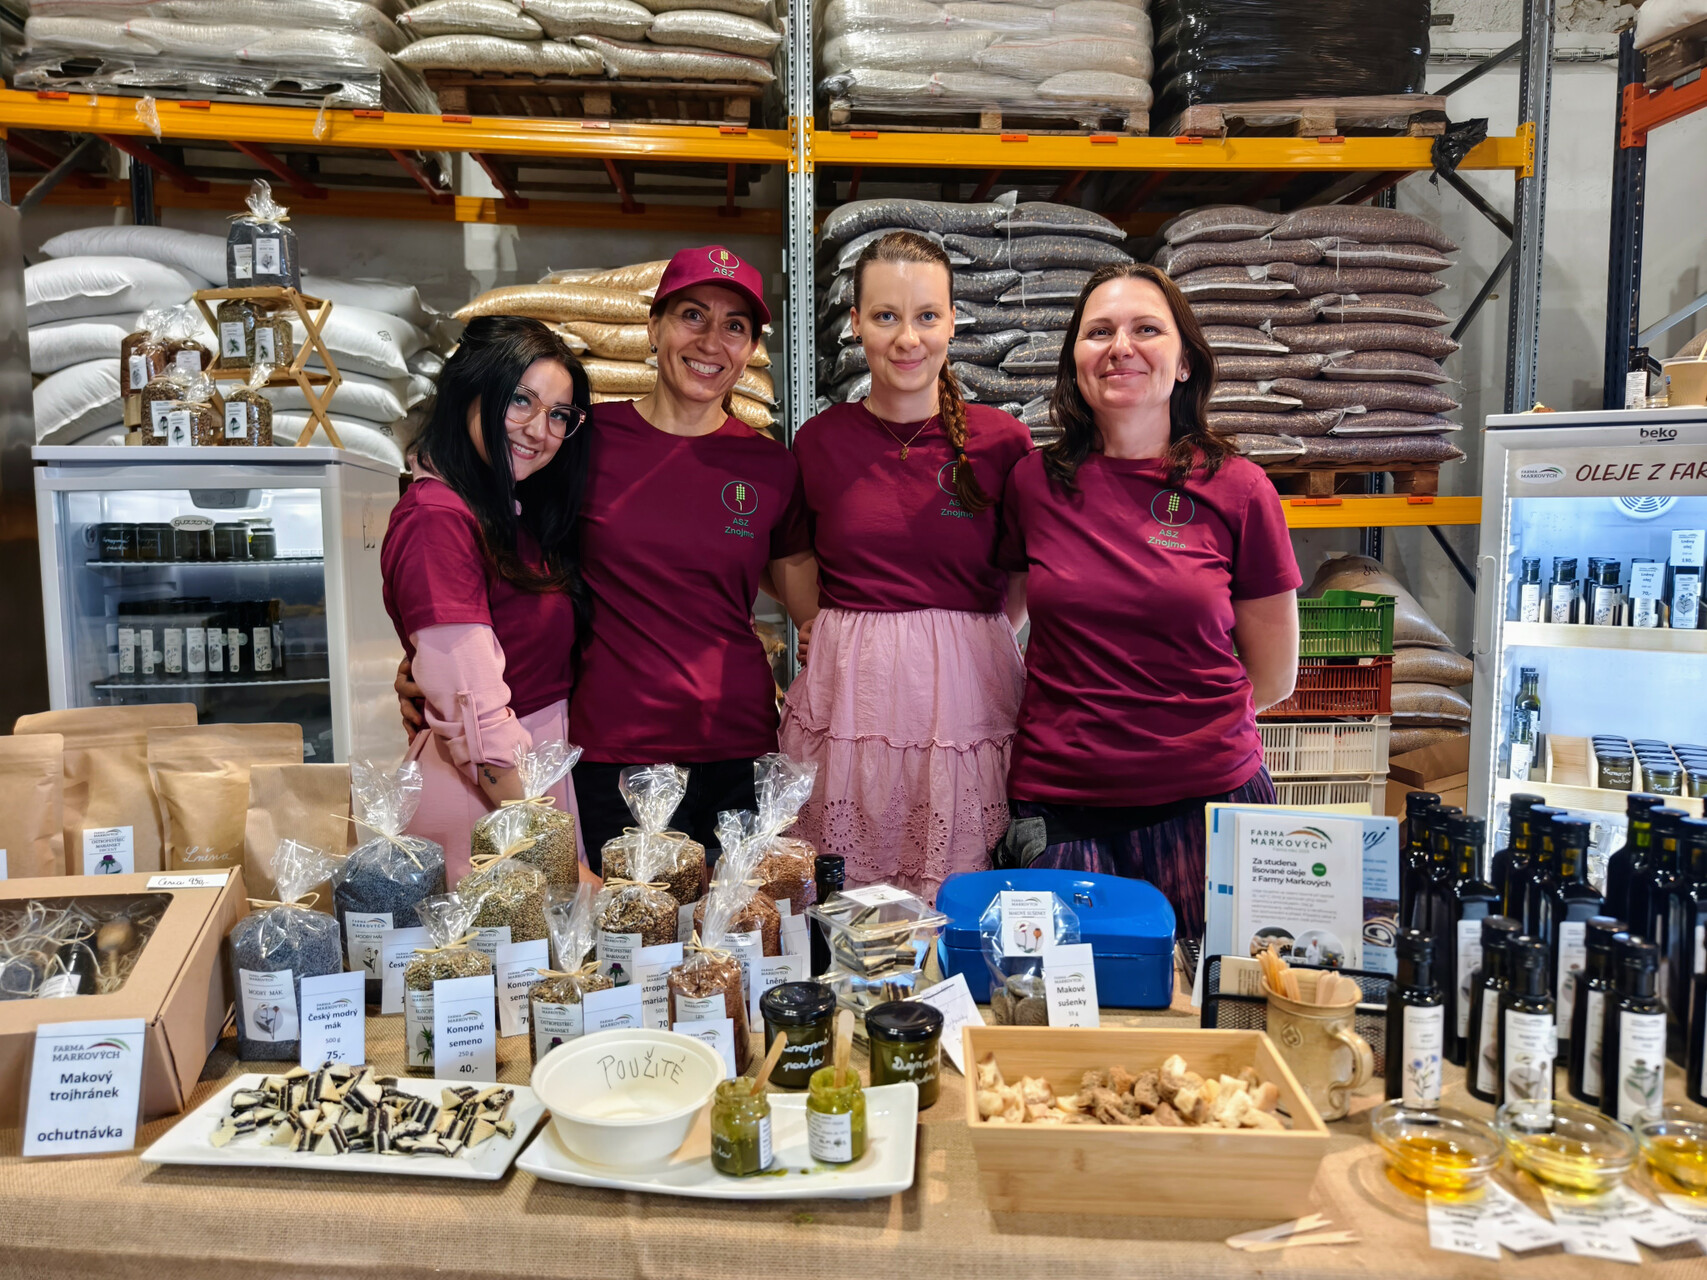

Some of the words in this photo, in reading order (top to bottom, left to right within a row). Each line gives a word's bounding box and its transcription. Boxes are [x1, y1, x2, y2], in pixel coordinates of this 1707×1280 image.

[713, 267, 735, 278] ASZ
[1640, 428, 1677, 438] beko
[1575, 463, 1643, 482] OLEJE
[1647, 463, 1666, 481] Z
[941, 508, 974, 519] Znojmo
[733, 517, 749, 527] ASZ
[725, 526, 754, 539] Znojmo
[1159, 529, 1179, 539] ASZ
[1147, 536, 1186, 549] Znojmo
[1250, 829, 1285, 837] FARMA
[1251, 838, 1327, 850] MARKOVÝCH
[1264, 859, 1297, 867] studena
[1252, 866, 1284, 875] lisované
[1286, 869, 1306, 877] oleje
[1258, 876, 1284, 885] Farmy
[1285, 878, 1331, 888] Markových
[269, 988, 283, 996] MÁK
[1058, 999, 1086, 1007] sušenky
[308, 1013, 330, 1022] Český
[333, 1009, 358, 1019] modrý
[325, 1022, 341, 1030] mák
[447, 1022, 484, 1034] Konopné
[449, 1038, 482, 1048] semeno
[53, 1045, 84, 1053] FARMA
[53, 1050, 120, 1062] MARKOVÝCH
[326, 1050, 345, 1060] 75,-
[459, 1064, 478, 1073] 40,-
[597, 1046, 686, 1089] POUŽITÉ
[60, 1070, 113, 1084] Makový
[50, 1086, 120, 1101] trojhránek
[37, 1125, 123, 1142] ochutnávka
